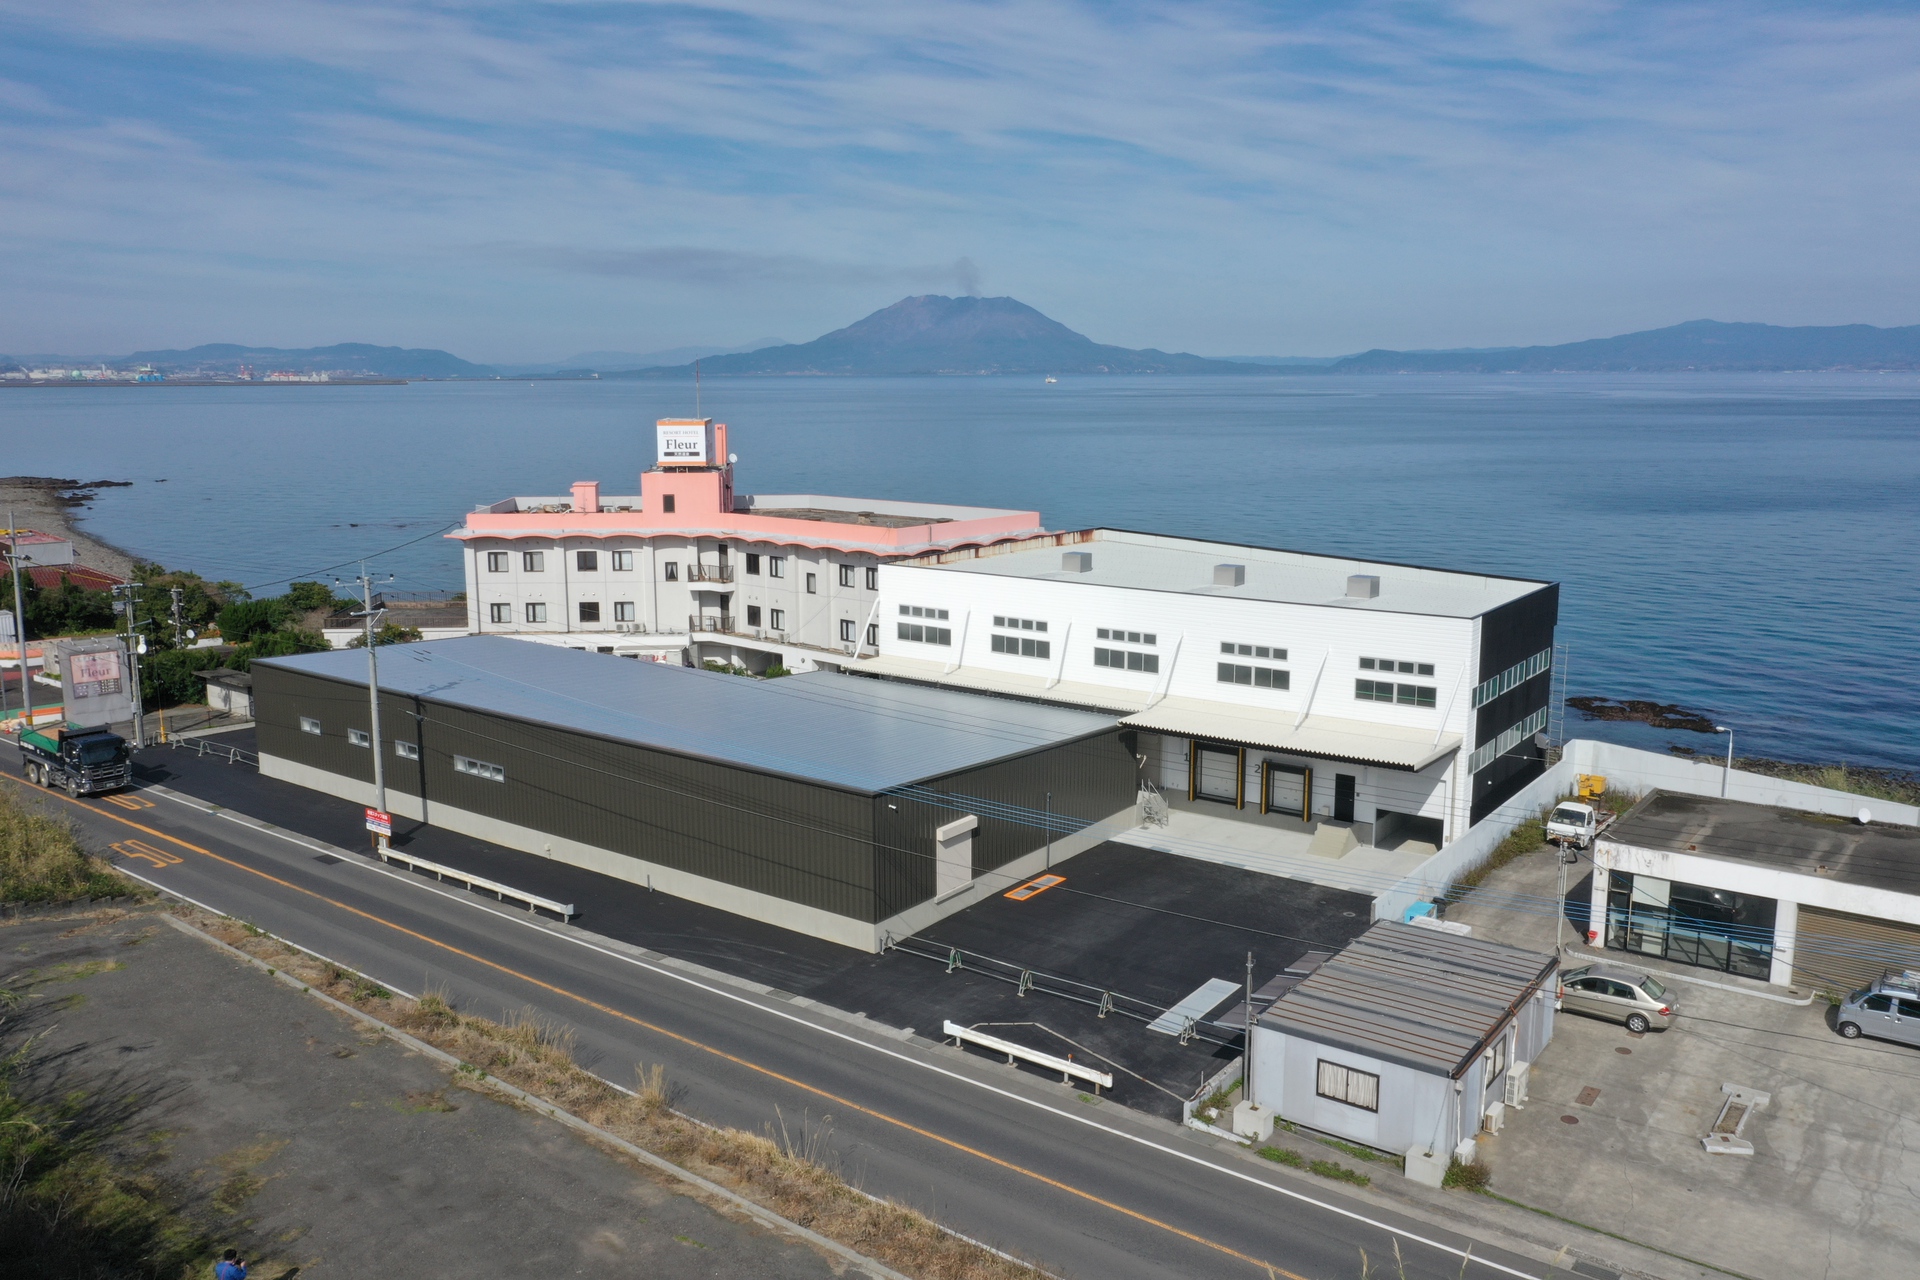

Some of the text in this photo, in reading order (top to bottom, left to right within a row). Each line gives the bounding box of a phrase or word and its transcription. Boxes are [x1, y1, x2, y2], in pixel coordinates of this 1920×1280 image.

[666, 439, 698, 449] Fleur
[81, 668, 111, 678] Fleur
[1184, 752, 1189, 761] 1
[1254, 764, 1261, 773] 2
